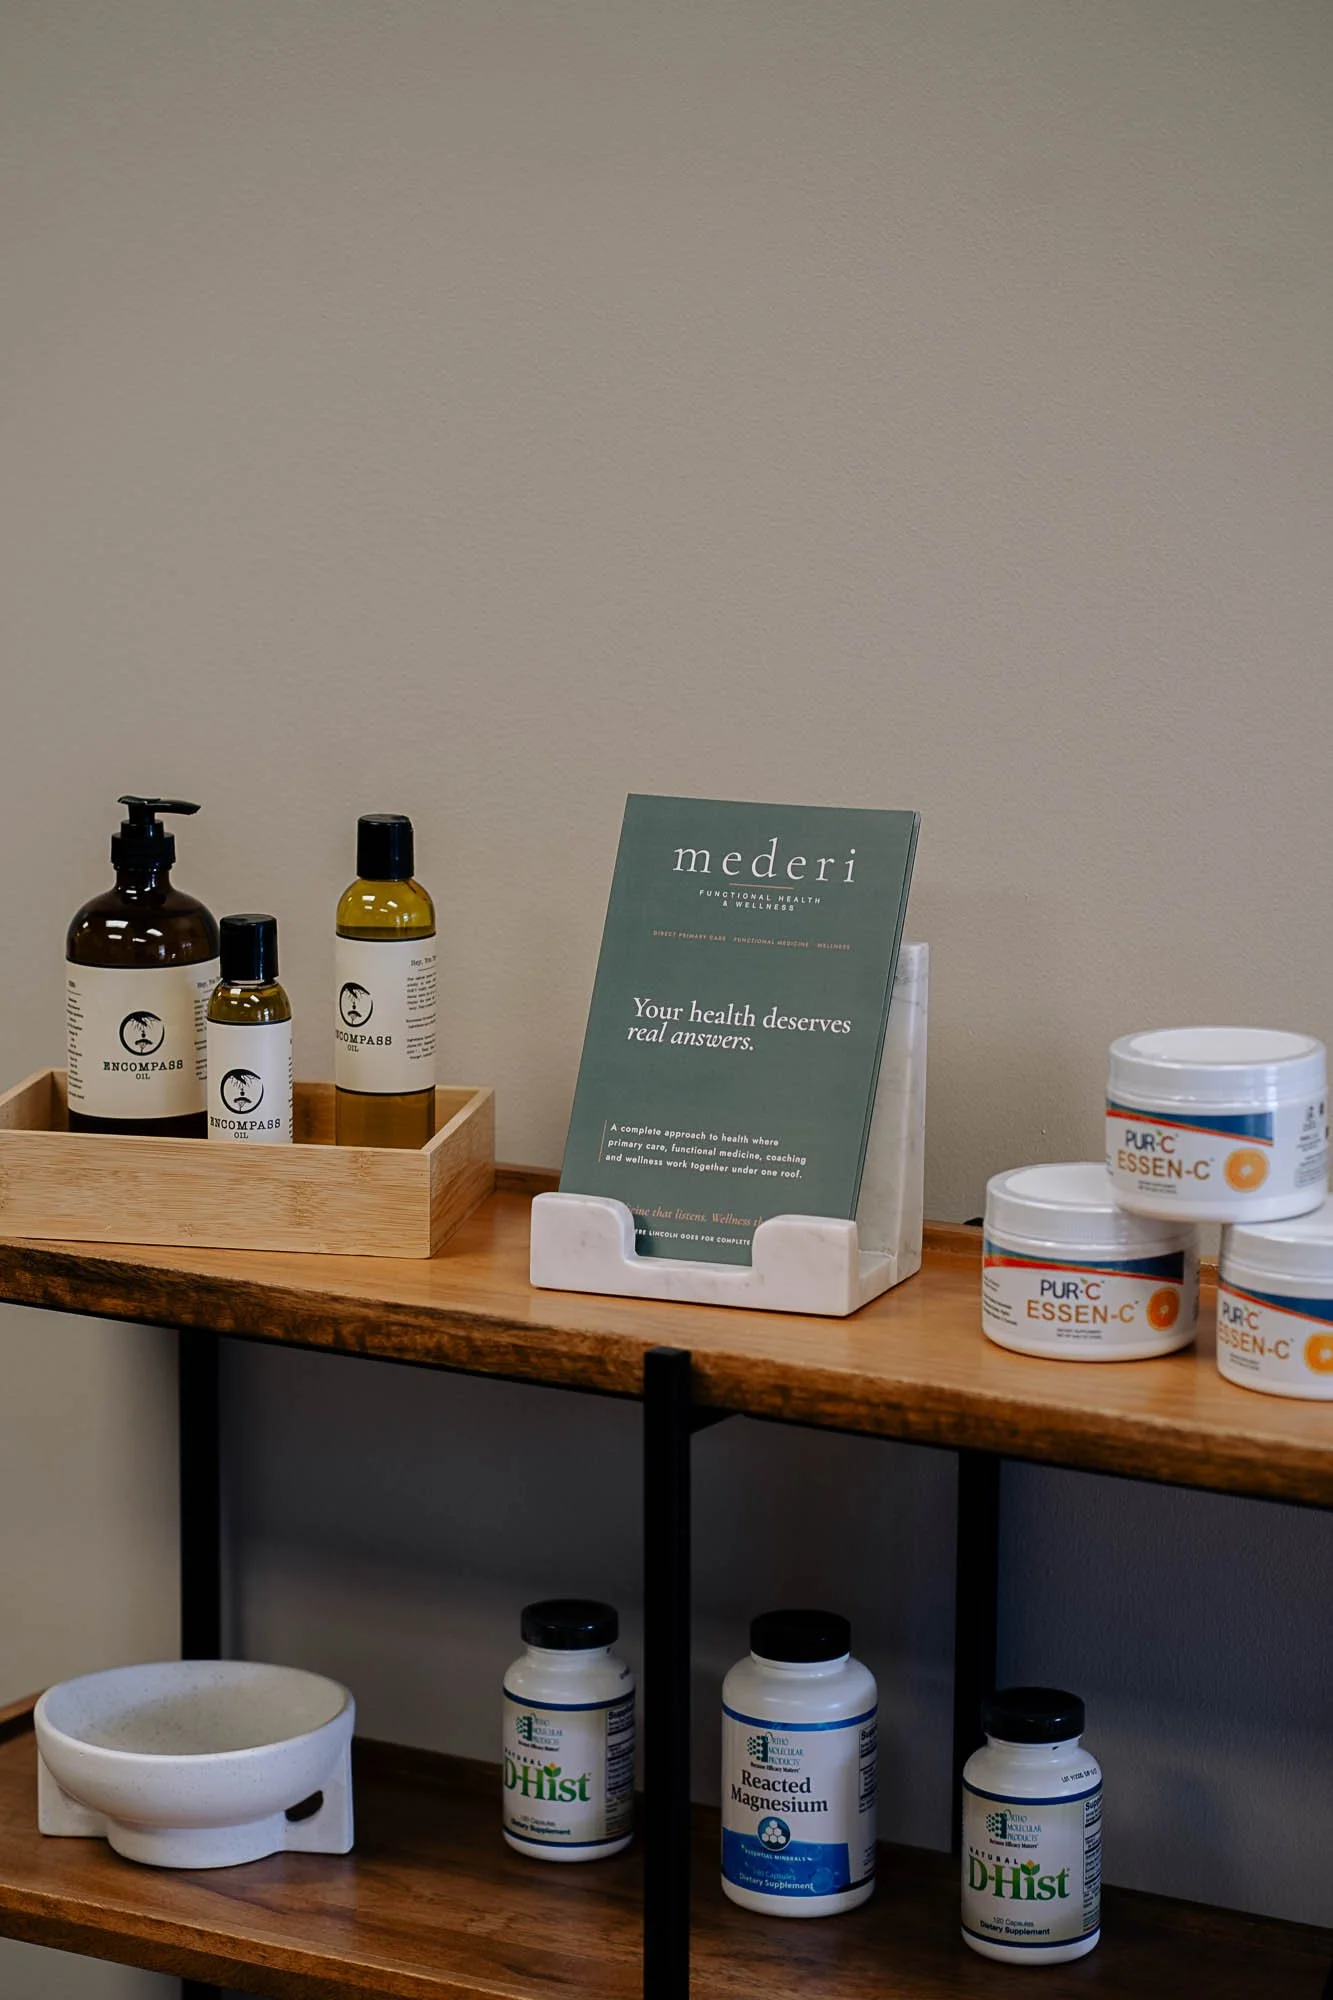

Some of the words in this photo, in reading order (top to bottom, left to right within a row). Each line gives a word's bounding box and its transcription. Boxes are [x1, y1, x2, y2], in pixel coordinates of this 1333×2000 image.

[672, 837, 856, 883] mederi
[699, 889, 772, 901] FUNCTIONAL
[778, 894, 821, 904] HEALTH
[735, 901, 795, 911] WELLNESS
[633, 997, 684, 1021] Your
[688, 1000, 756, 1027] health
[762, 1006, 851, 1034] deserves
[627, 1022, 668, 1043] real
[670, 1030, 754, 1051] answers.
[346, 1044, 360, 1053] OIL
[103, 1059, 184, 1072] ENCOMPASS
[135, 1072, 151, 1080] OIL
[209, 1116, 281, 1131] ENCOMPASS
[610, 1123, 617, 1131] A
[620, 1126, 662, 1136] complete
[664, 1130, 706, 1140] approach
[709, 1133, 718, 1141] to
[721, 1132, 749, 1144] health
[752, 1137, 779, 1146] where
[607, 1139, 643, 1151] primary
[645, 1143, 668, 1153] care,
[671, 1143, 717, 1156] functional
[719, 1148, 762, 1161] medicine,
[766, 1153, 807, 1166] coaching
[605, 1154, 623, 1162] and
[625, 1155, 663, 1166] wellness
[666, 1160, 687, 1168] work
[691, 1161, 729, 1172] together
[731, 1165, 758, 1175] under
[761, 1169, 778, 1177] one
[780, 1169, 802, 1179] roof.
[1116, 1150, 1210, 1180] ESSEN-C
[652, 1205, 672, 1218] that
[711, 1212, 751, 1226] Wellness
[648, 1230, 679, 1239] LINCOLN
[680, 1233, 699, 1241] GOES
[716, 1237, 751, 1246] COMPLETE
[1026, 1299, 1135, 1325] ESSEN-C
[504, 1756, 591, 1802] D-Hist
[741, 1769, 811, 1793] Reacted
[731, 1784, 828, 1813] Magnesium
[774, 1854, 806, 1862] MINERALS
[969, 1847, 1019, 1865] NATURAL
[739, 1872, 763, 1886] Dietary
[764, 1879, 814, 1890] Supplement
[969, 1855, 1070, 1901] D-Hist
[980, 1920, 1003, 1934] Dietary
[1005, 1926, 1051, 1936] Supplement
